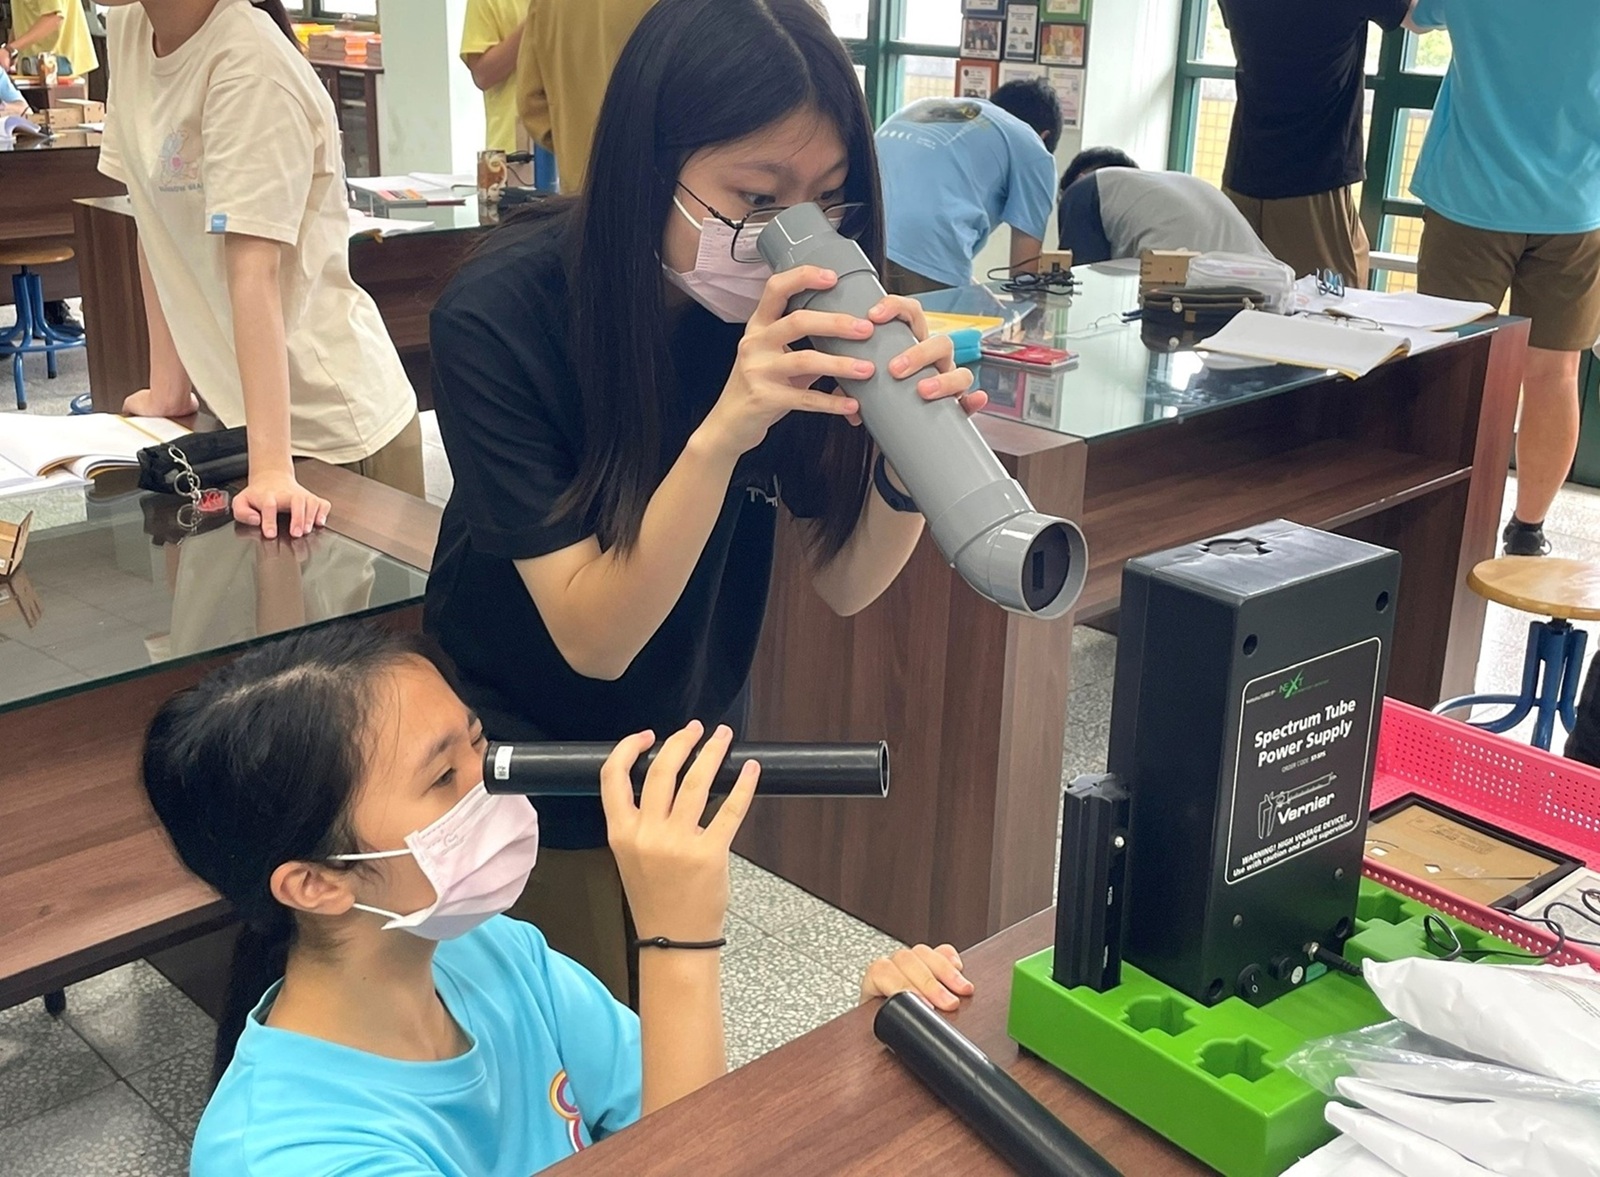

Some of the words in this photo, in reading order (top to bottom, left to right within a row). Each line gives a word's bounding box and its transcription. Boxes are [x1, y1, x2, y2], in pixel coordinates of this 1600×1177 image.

[1254, 712, 1321, 749] Spectrum
[1324, 700, 1356, 721] Tube
[1258, 739, 1304, 767] Power
[1306, 719, 1353, 748] Supply
[1277, 793, 1335, 825] Vernier
